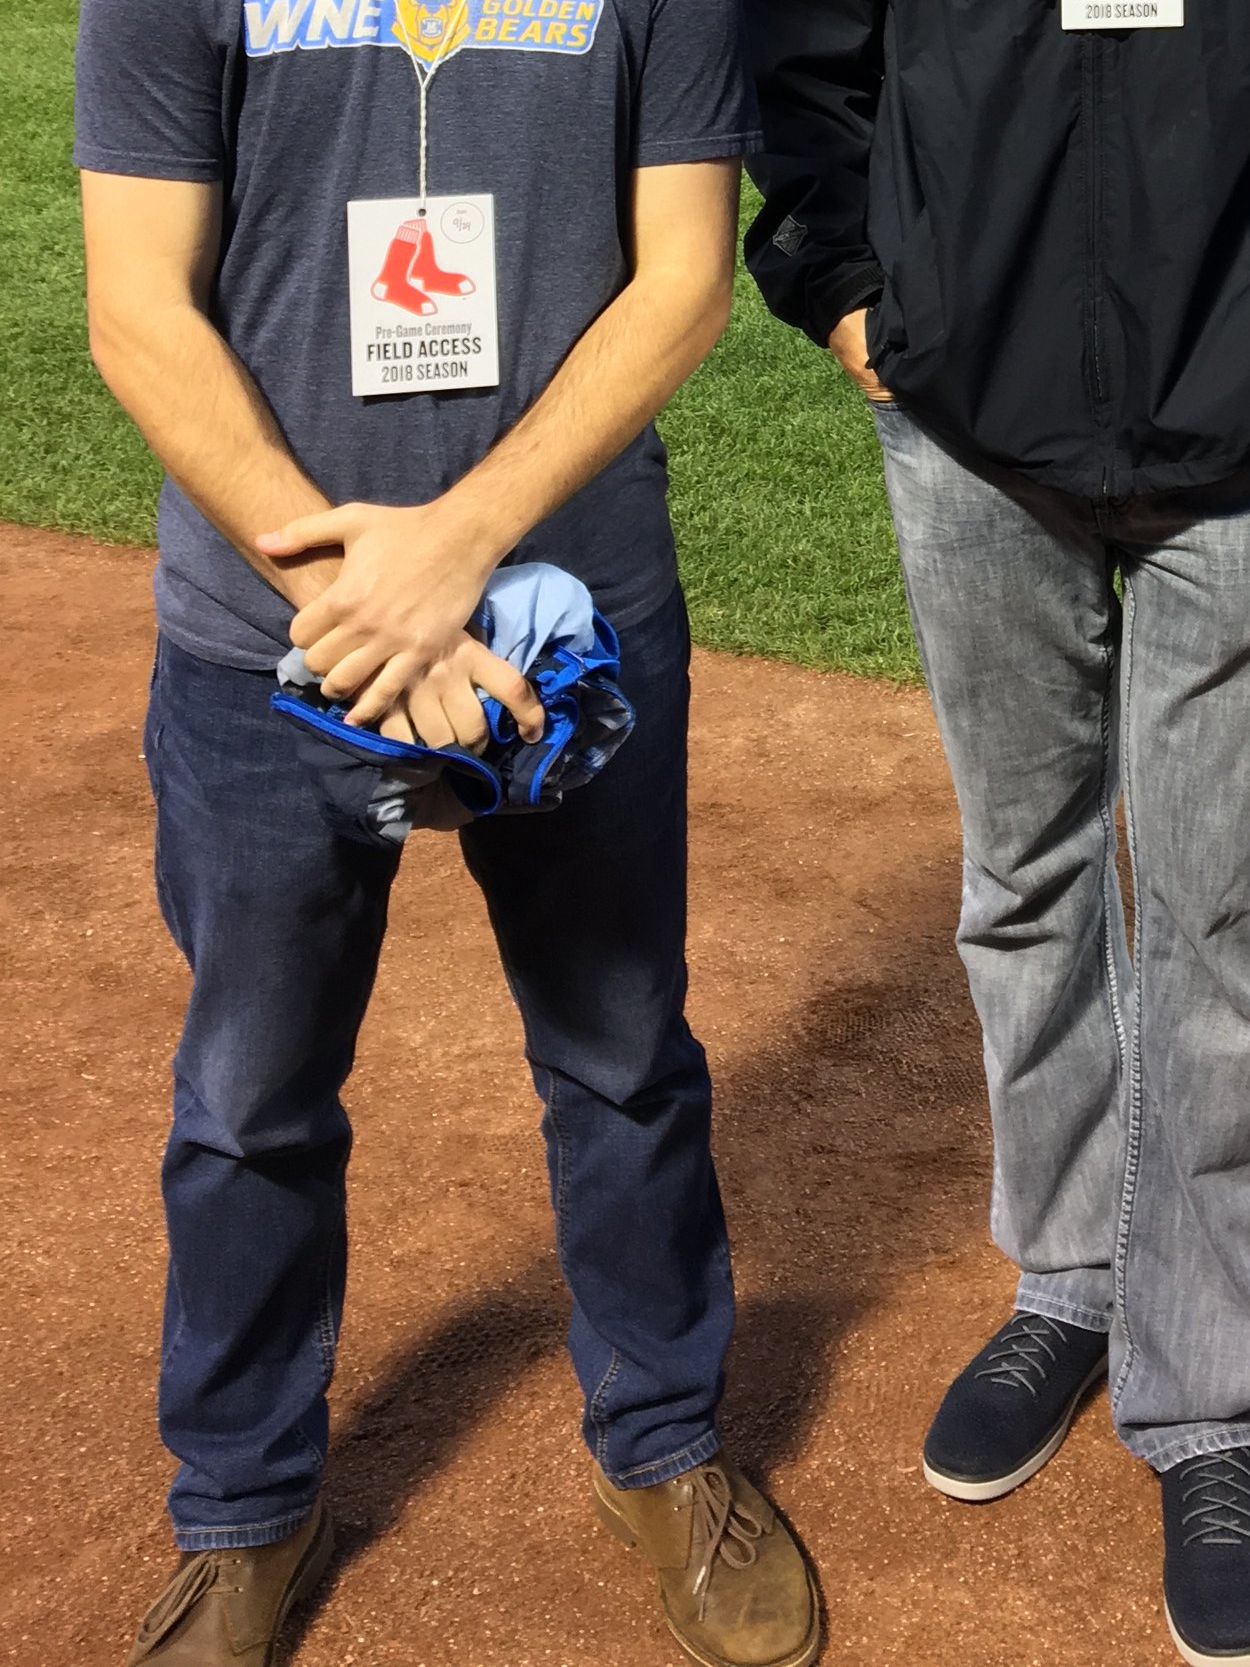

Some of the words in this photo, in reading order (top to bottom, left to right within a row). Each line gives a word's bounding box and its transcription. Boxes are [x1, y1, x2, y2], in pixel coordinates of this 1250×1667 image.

[1085, 5, 1113, 19] 2018
[1114, 3, 1158, 18] SEASON
[475, 18, 590, 47] BEARS
[375, 324, 423, 339] Pre-Game
[424, 322, 473, 339] Ceremony
[366, 342, 413, 362] FIELD
[417, 337, 482, 359] ACCESS
[381, 365, 413, 383] 2018
[416, 361, 468, 380] SEASON
